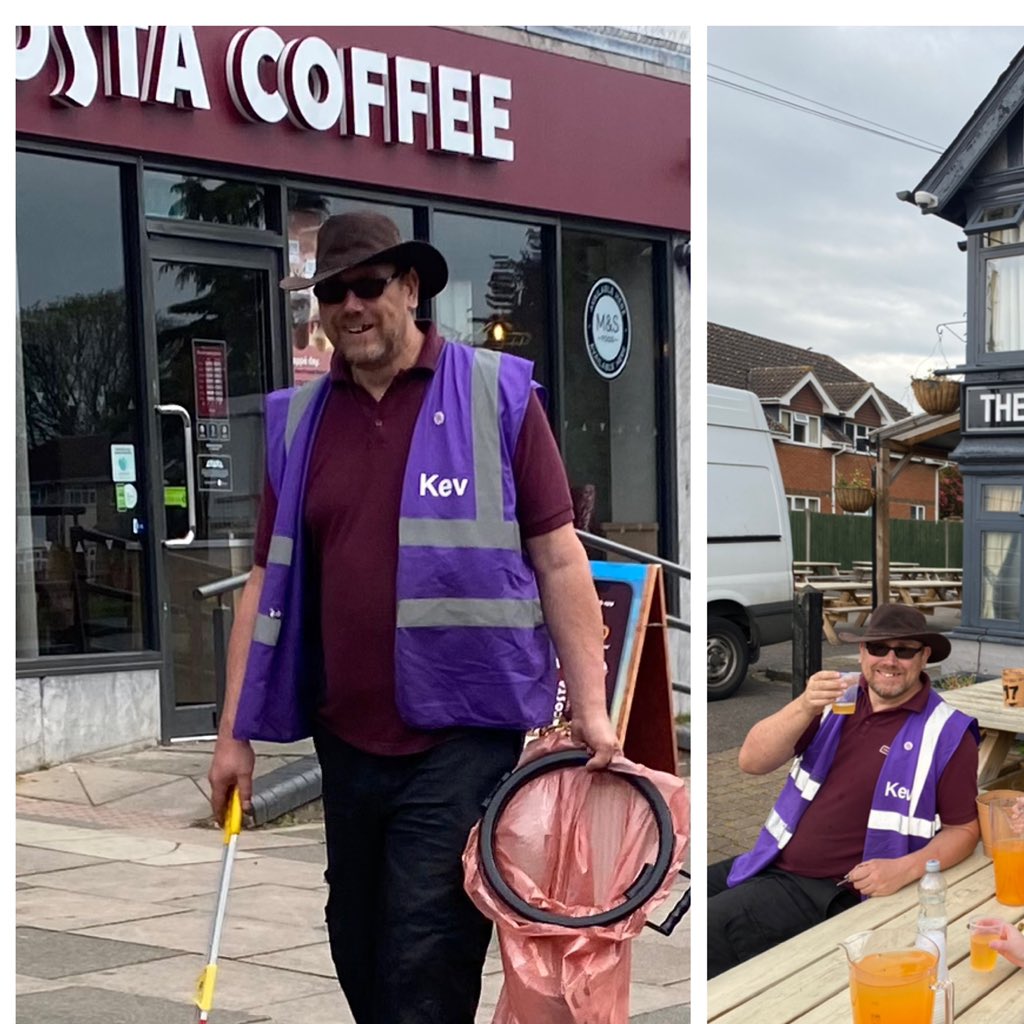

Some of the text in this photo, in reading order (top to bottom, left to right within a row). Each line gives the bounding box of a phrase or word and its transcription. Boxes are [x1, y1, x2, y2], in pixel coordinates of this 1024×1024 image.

[16, 26, 514, 161] STA COFFEE
[596, 313, 620, 333] M&S
[420, 473, 468, 498] Kev
